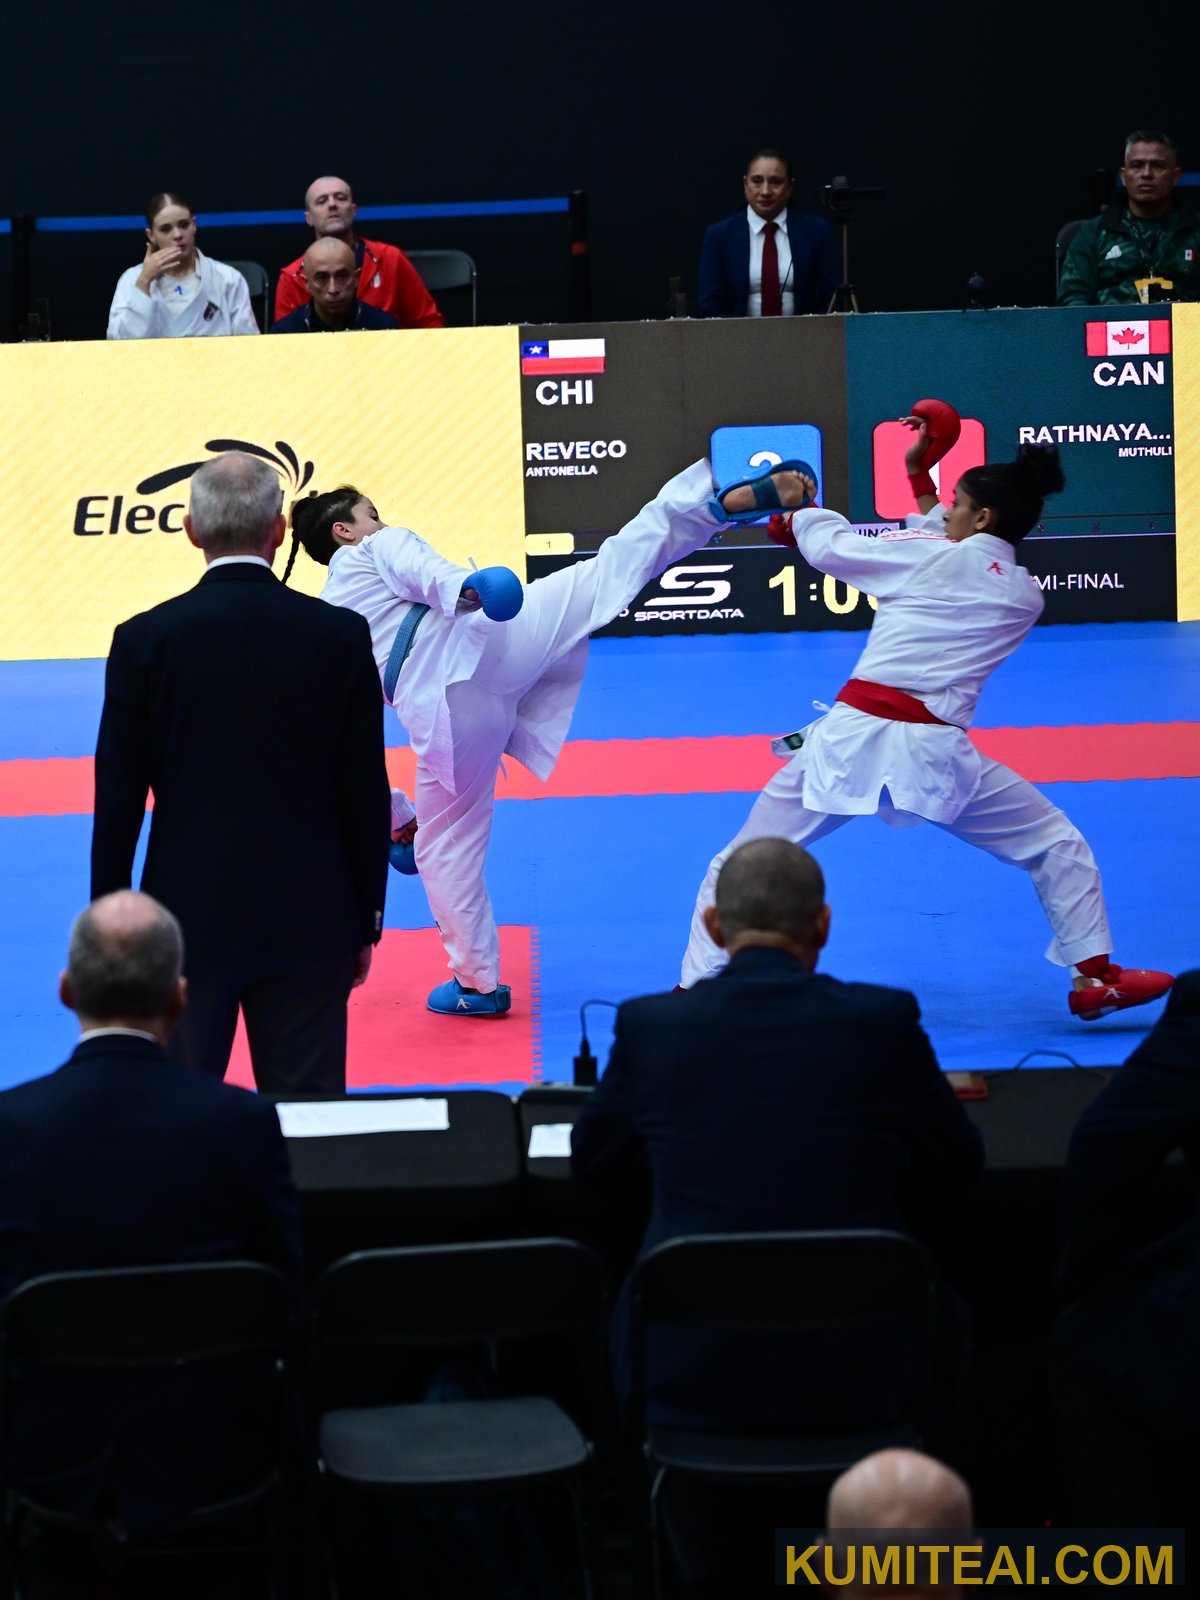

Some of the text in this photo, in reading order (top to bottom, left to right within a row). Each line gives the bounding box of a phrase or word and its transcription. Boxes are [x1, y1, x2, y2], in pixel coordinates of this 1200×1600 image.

[1093, 361, 1165, 387] CAN
[535, 380, 594, 406] CHI
[1019, 423, 1171, 444] RATHNAYA...
[525, 440, 627, 461] REVECO
[1118, 446, 1172, 457] MUTHULI
[525, 464, 598, 477] ANTONELLA
[546, 541, 551, 549] 1
[768, 565, 880, 616] 1:0
[1032, 572, 1125, 591] MI-FINAL
[634, 608, 745, 622] SPORTDATA
